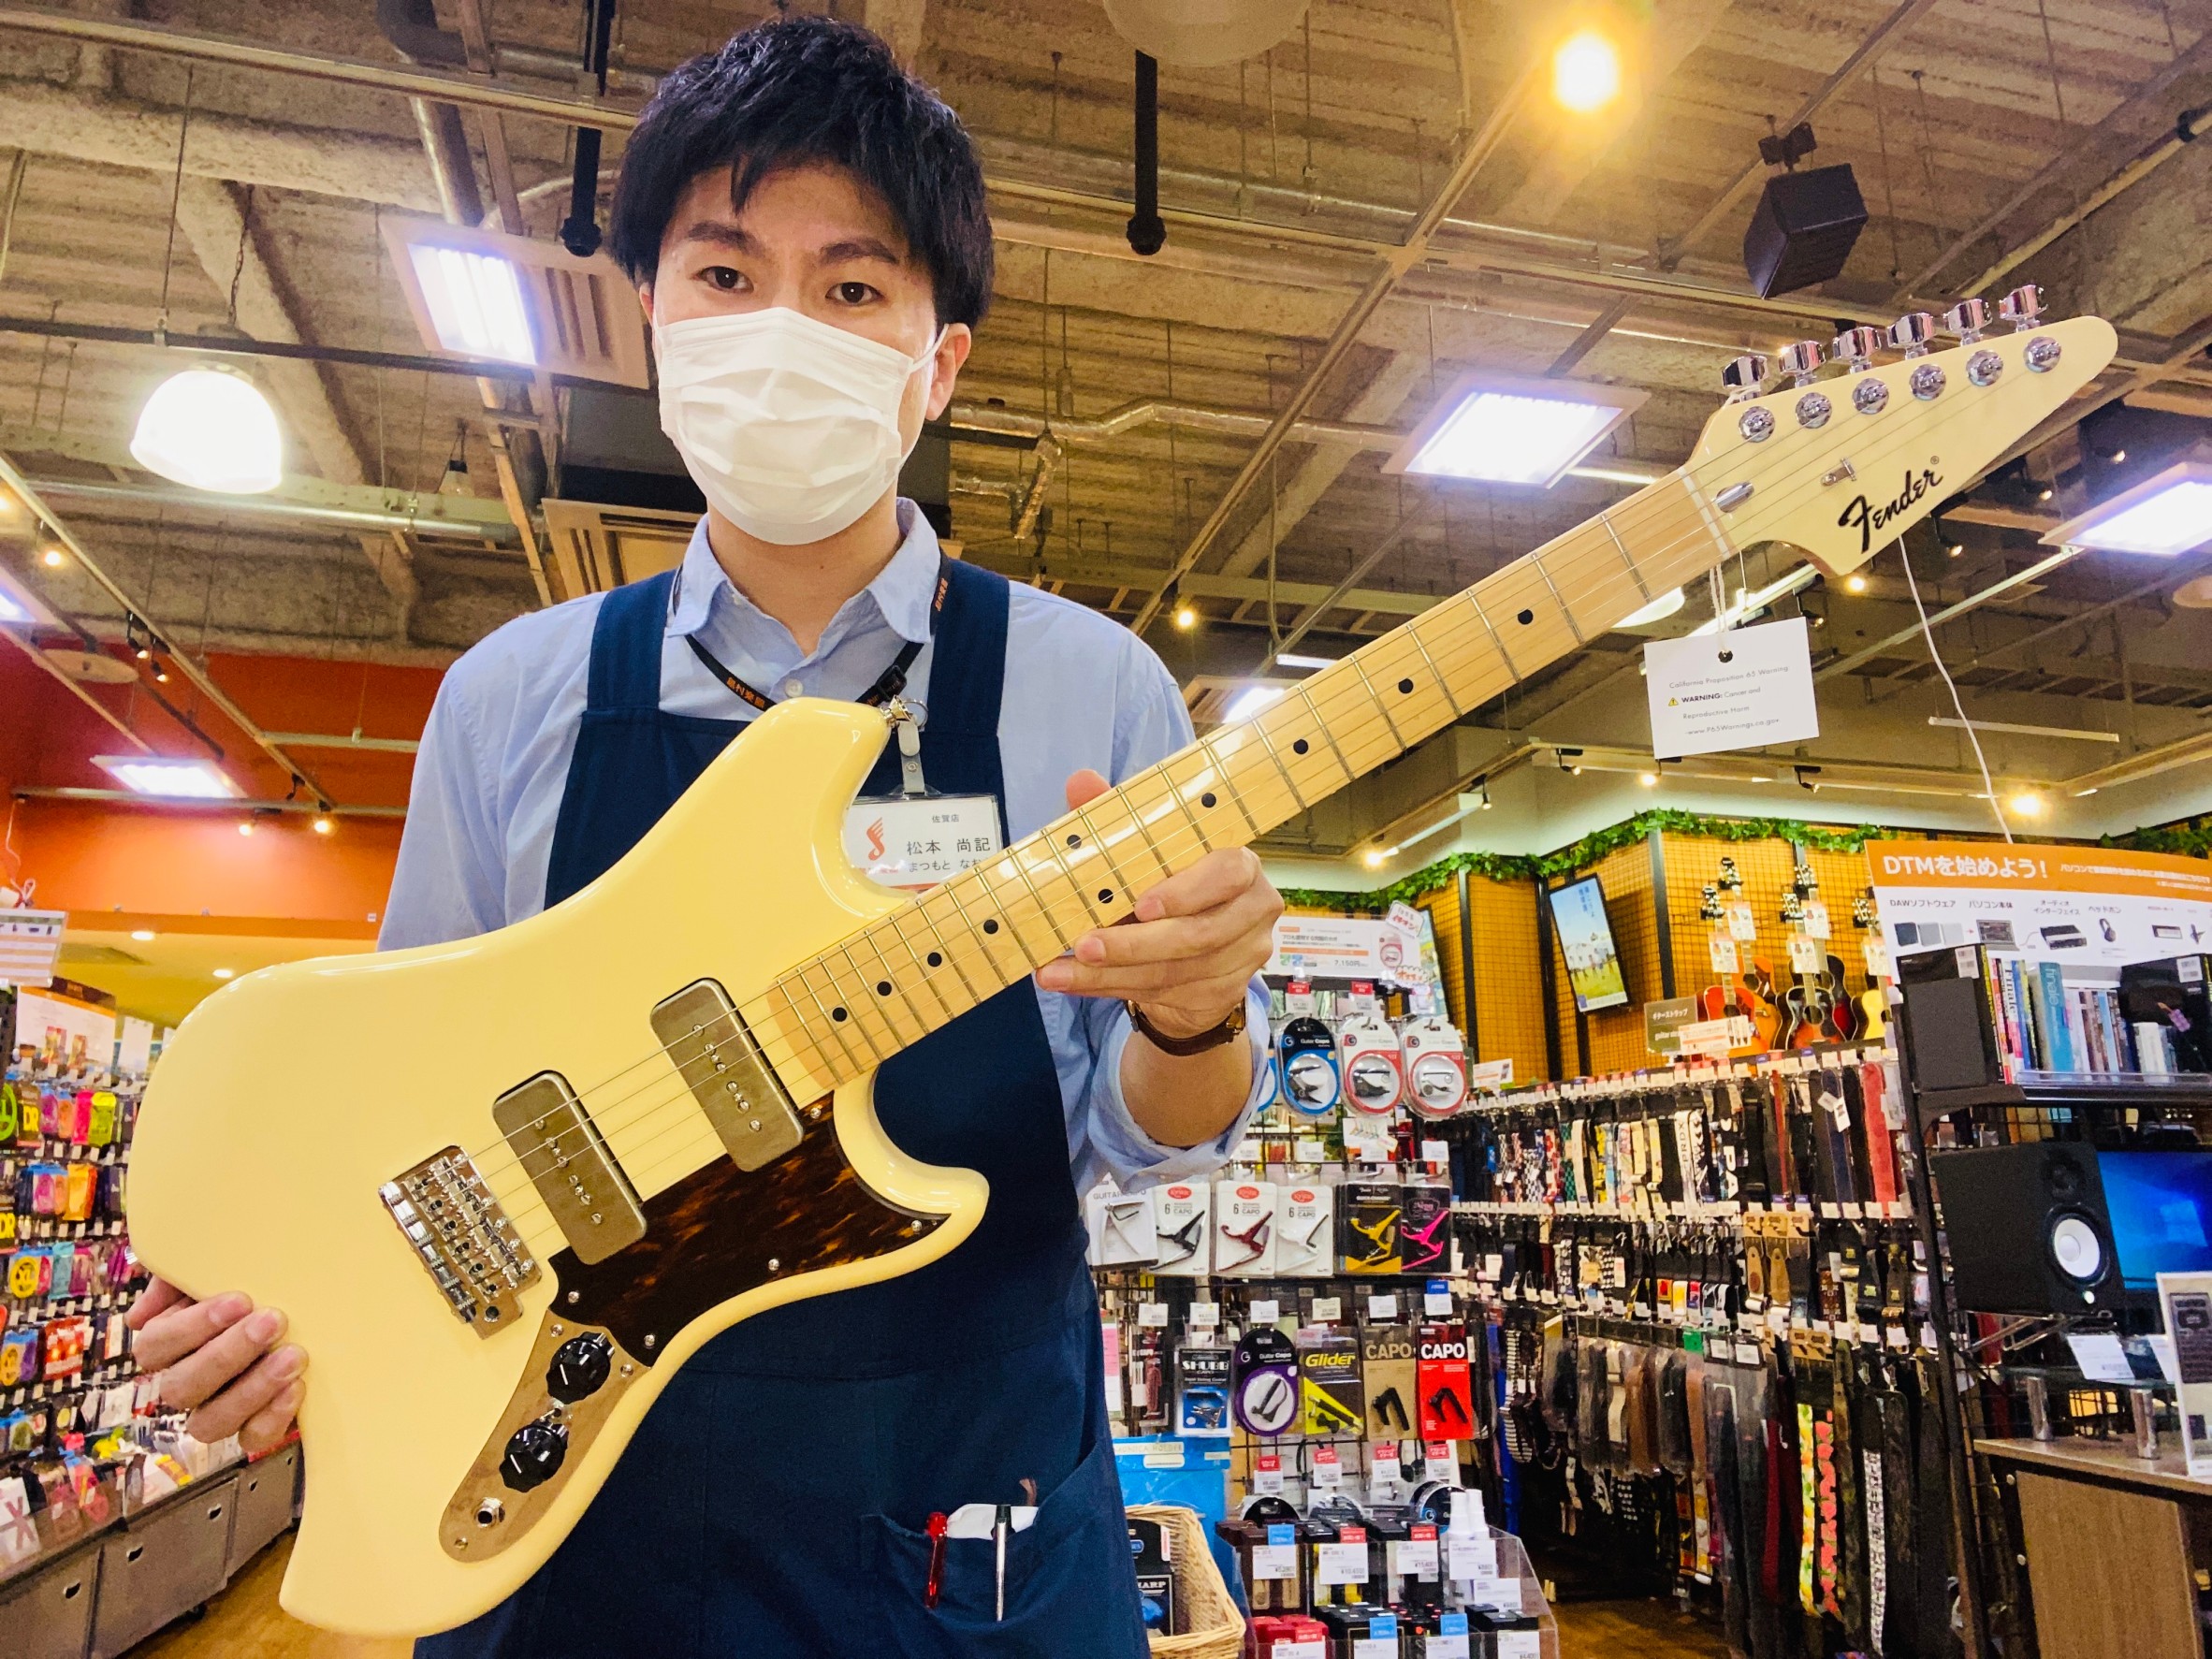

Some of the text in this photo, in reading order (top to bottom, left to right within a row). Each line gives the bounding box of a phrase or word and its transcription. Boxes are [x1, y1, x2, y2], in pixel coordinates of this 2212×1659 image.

[1838, 470, 1943, 554] Fender
[1669, 679, 1704, 690] California
[1706, 673, 1744, 685] Proposition
[1758, 665, 1789, 676] Warning
[1681, 692, 1723, 703] WARNING:
[1724, 690, 1747, 698] Cancer
[1683, 708, 1728, 720] Reproductive
[931, 814, 960, 823] 佐賀店
[907, 837, 991, 855] 松本 尚記
[909, 860, 952, 872] まつもと
[960, 859, 988, 869] なお
[1889, 899, 1957, 908] DAWソフトウェア
[1969, 900, 2014, 909] パソコン本体
[2088, 906, 2122, 914] ヘッドホン
[2005, 968, 2016, 1011] Finale
[2045, 968, 2059, 1005] finale
[1652, 1008, 1688, 1021] ギターストラップ
[23, 1105, 39, 1131] DR
[1164, 1204, 1171, 1214] 6
[1233, 1204, 1239, 1214] 6
[1288, 1207, 1295, 1217] 6
[1366, 1344, 1412, 1360] CAPO
[1420, 1343, 1466, 1360] CAPO
[1182, 1361, 1230, 1371] SHUBB
[1305, 1353, 1356, 1368] Glider
